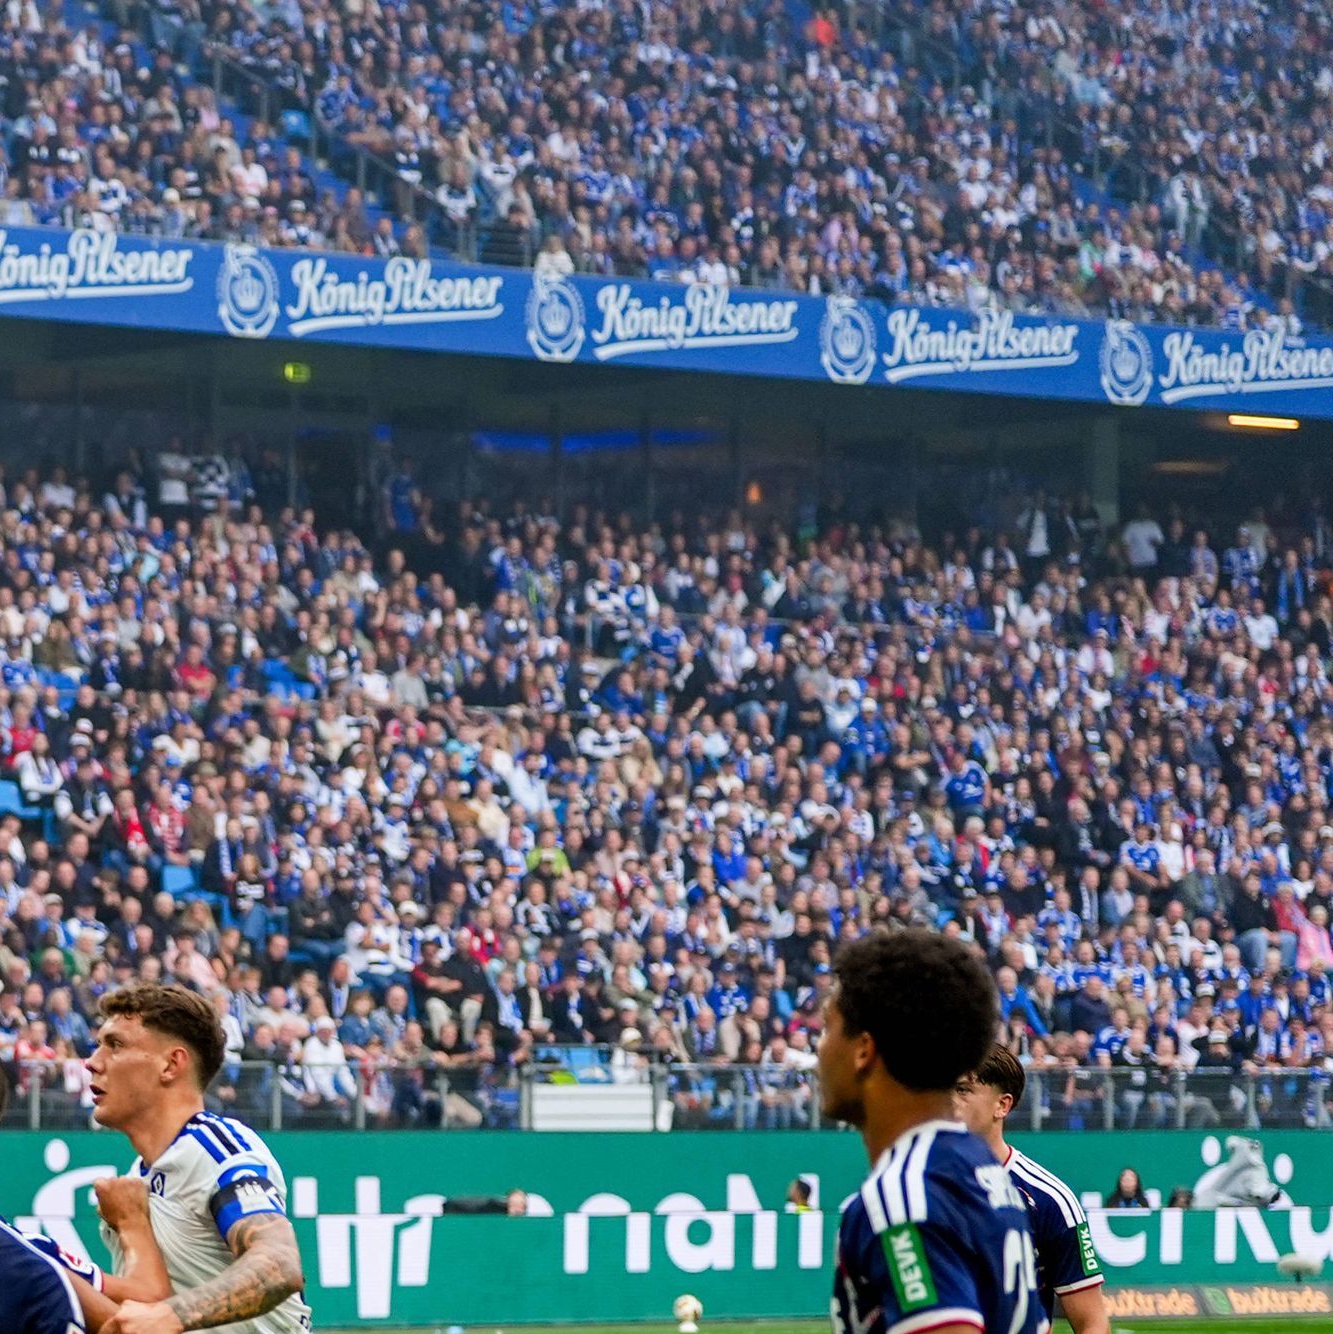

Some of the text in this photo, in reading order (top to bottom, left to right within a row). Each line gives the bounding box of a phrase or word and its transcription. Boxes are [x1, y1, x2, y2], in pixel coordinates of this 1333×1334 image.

[1241, 325, 1333, 381] Pilsene
[888, 1227, 929, 1303] DEVK
[1080, 1227, 1099, 1271] DEVK
